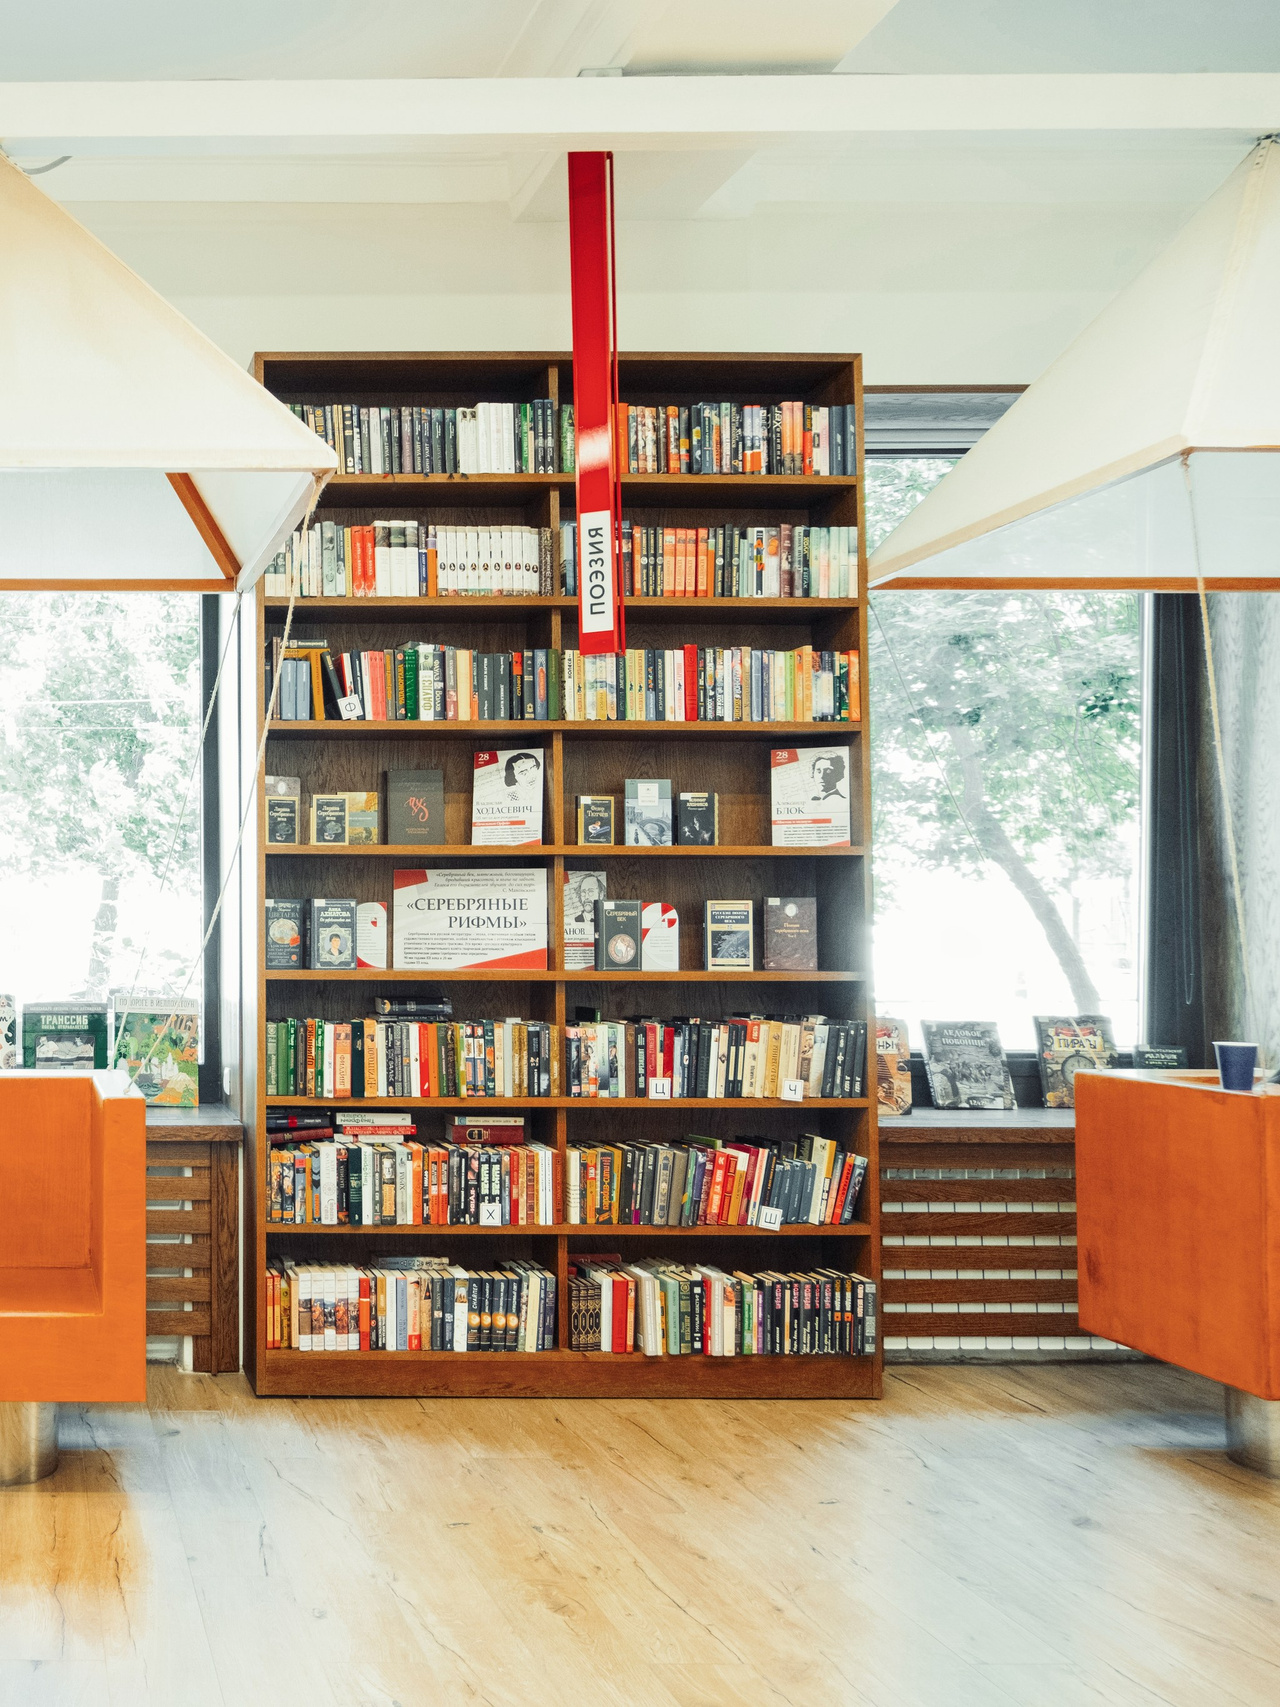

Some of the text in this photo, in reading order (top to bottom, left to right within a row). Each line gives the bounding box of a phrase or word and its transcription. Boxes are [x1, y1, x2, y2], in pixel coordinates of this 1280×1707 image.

[588, 526, 606, 615] ПОЭЗИЯ
[422, 679, 431, 711] ФАУЛЗ
[345, 701, 357, 713] Ф
[478, 753, 489, 761] 28
[776, 751, 788, 759] 28
[476, 805, 533, 815] ХОДАСЕВИЧ
[776, 806, 805, 815] БЛОК
[406, 898, 529, 911] «СЕРЕБРЯНЫЕ
[605, 909, 637, 917] СЕРЕБРЯНЫЙ
[448, 915, 527, 929] РИФМЫ»
[119, 999, 128, 1007] ПО
[150, 999, 154, 1007] В
[40, 1015, 89, 1025] ТРАНССИБ
[943, 1028, 982, 1038] ЛЕДОВОЕ
[941, 1037, 986, 1047] ПОБОИЩЕ
[655, 1083, 665, 1095] Ц
[486, 1208, 495, 1220] Х
[765, 1212, 776, 1224] Ш
